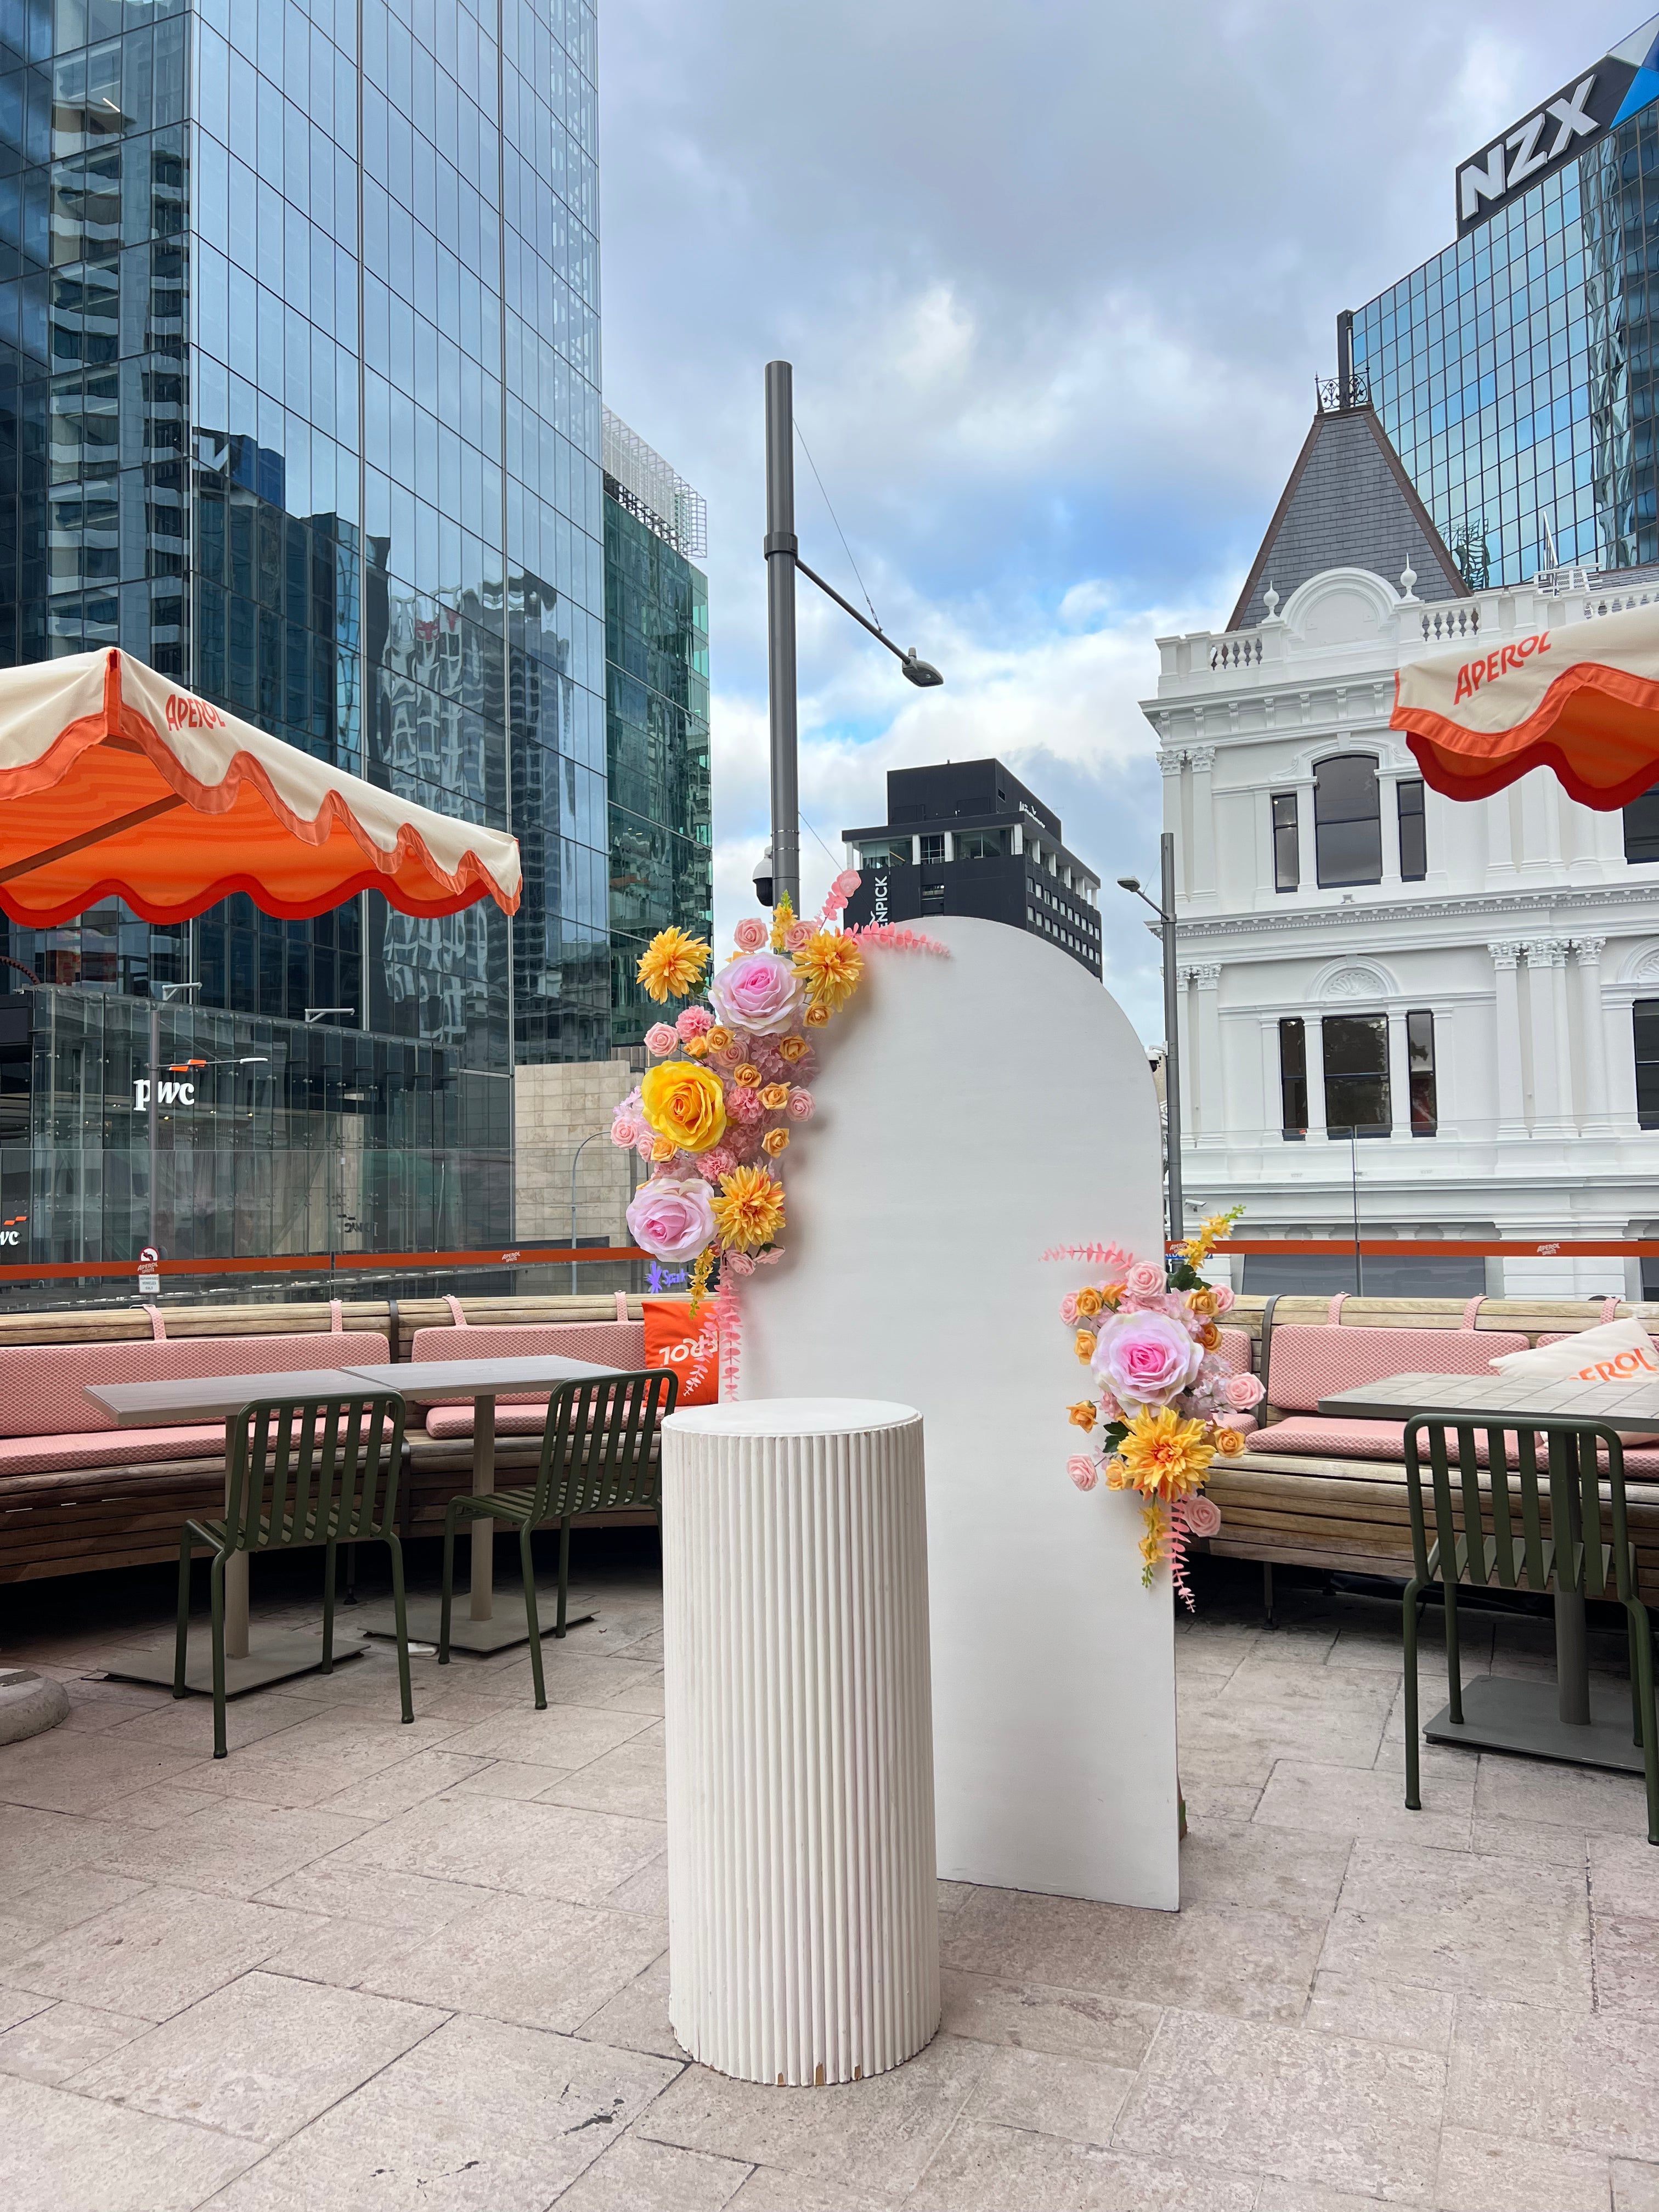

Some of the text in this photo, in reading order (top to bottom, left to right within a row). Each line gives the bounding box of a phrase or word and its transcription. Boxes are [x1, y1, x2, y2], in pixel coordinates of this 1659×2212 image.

[1460, 74, 1601, 221] NZX
[1454, 630, 1551, 706] APEROL
[165, 694, 226, 731] APEROL
[874, 876, 888, 927] NPICK
[133, 1079, 195, 1111] pwc
[0, 1231, 20, 1246] wc
[1537, 1243, 1561, 1253] APEROL
[137, 1262, 159, 1272] APEROL
[501, 1251, 521, 1260] APEROL
[662, 1268, 689, 1288] Spark
[659, 1330, 718, 1365] EROL
[1568, 1348, 1657, 1382] EROL
